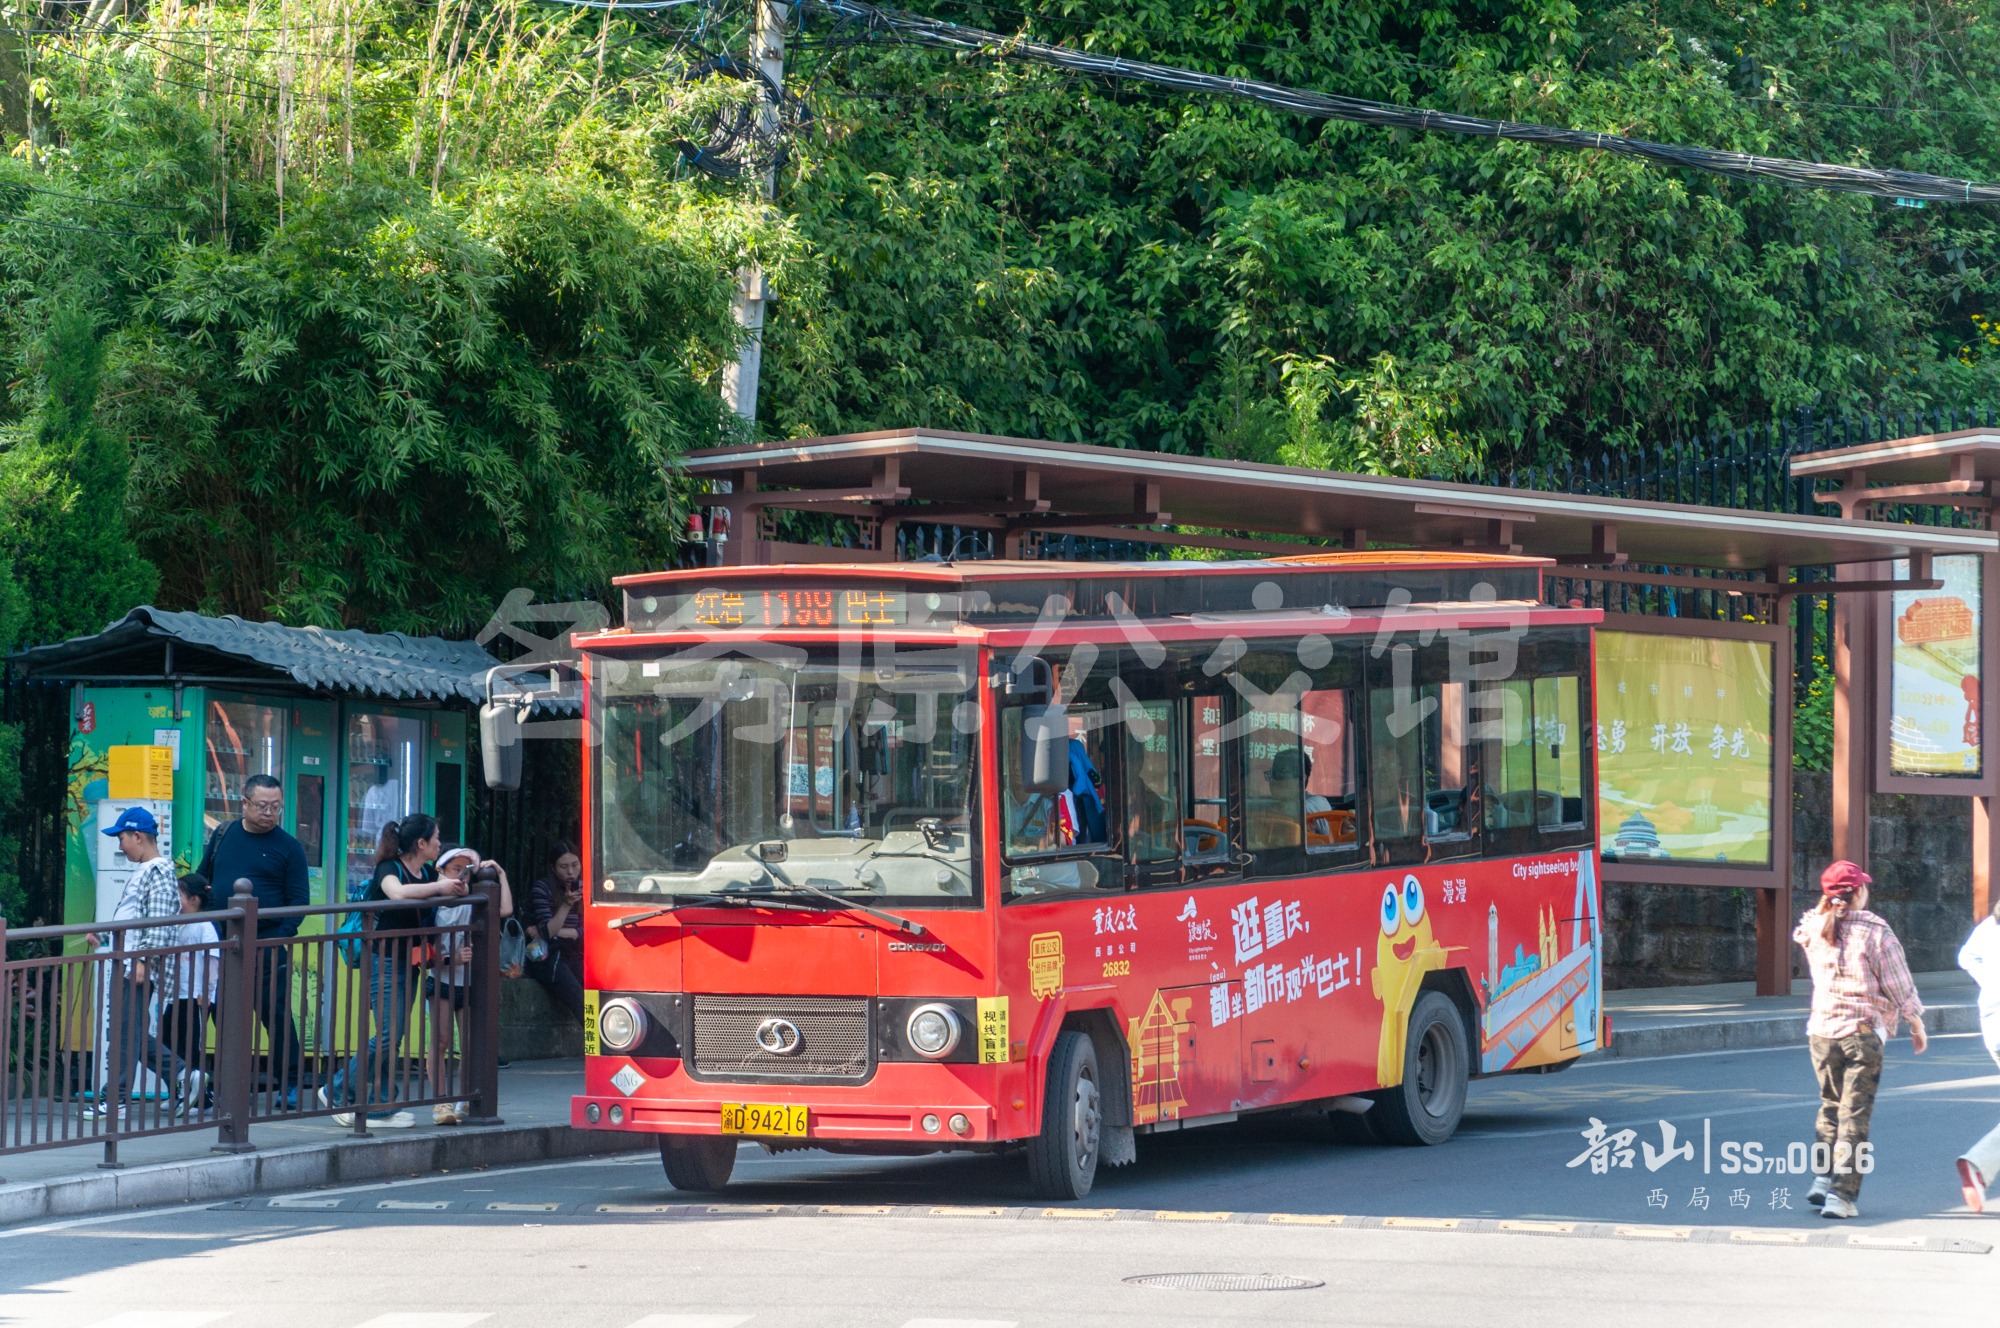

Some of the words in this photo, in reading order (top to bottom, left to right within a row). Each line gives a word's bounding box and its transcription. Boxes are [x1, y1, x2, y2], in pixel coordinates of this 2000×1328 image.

[846, 591, 895, 624] 巴士
[1512, 863, 1527, 881] City
[1528, 858, 1569, 880] sightseeing
[1034, 941, 1058, 955] 重庆公交
[1102, 959, 1130, 978] 26832
[983, 1010, 997, 1063] 视线盲区
[999, 1009, 1007, 1062] 请勿靠近
[615, 1072, 639, 1087] CNG
